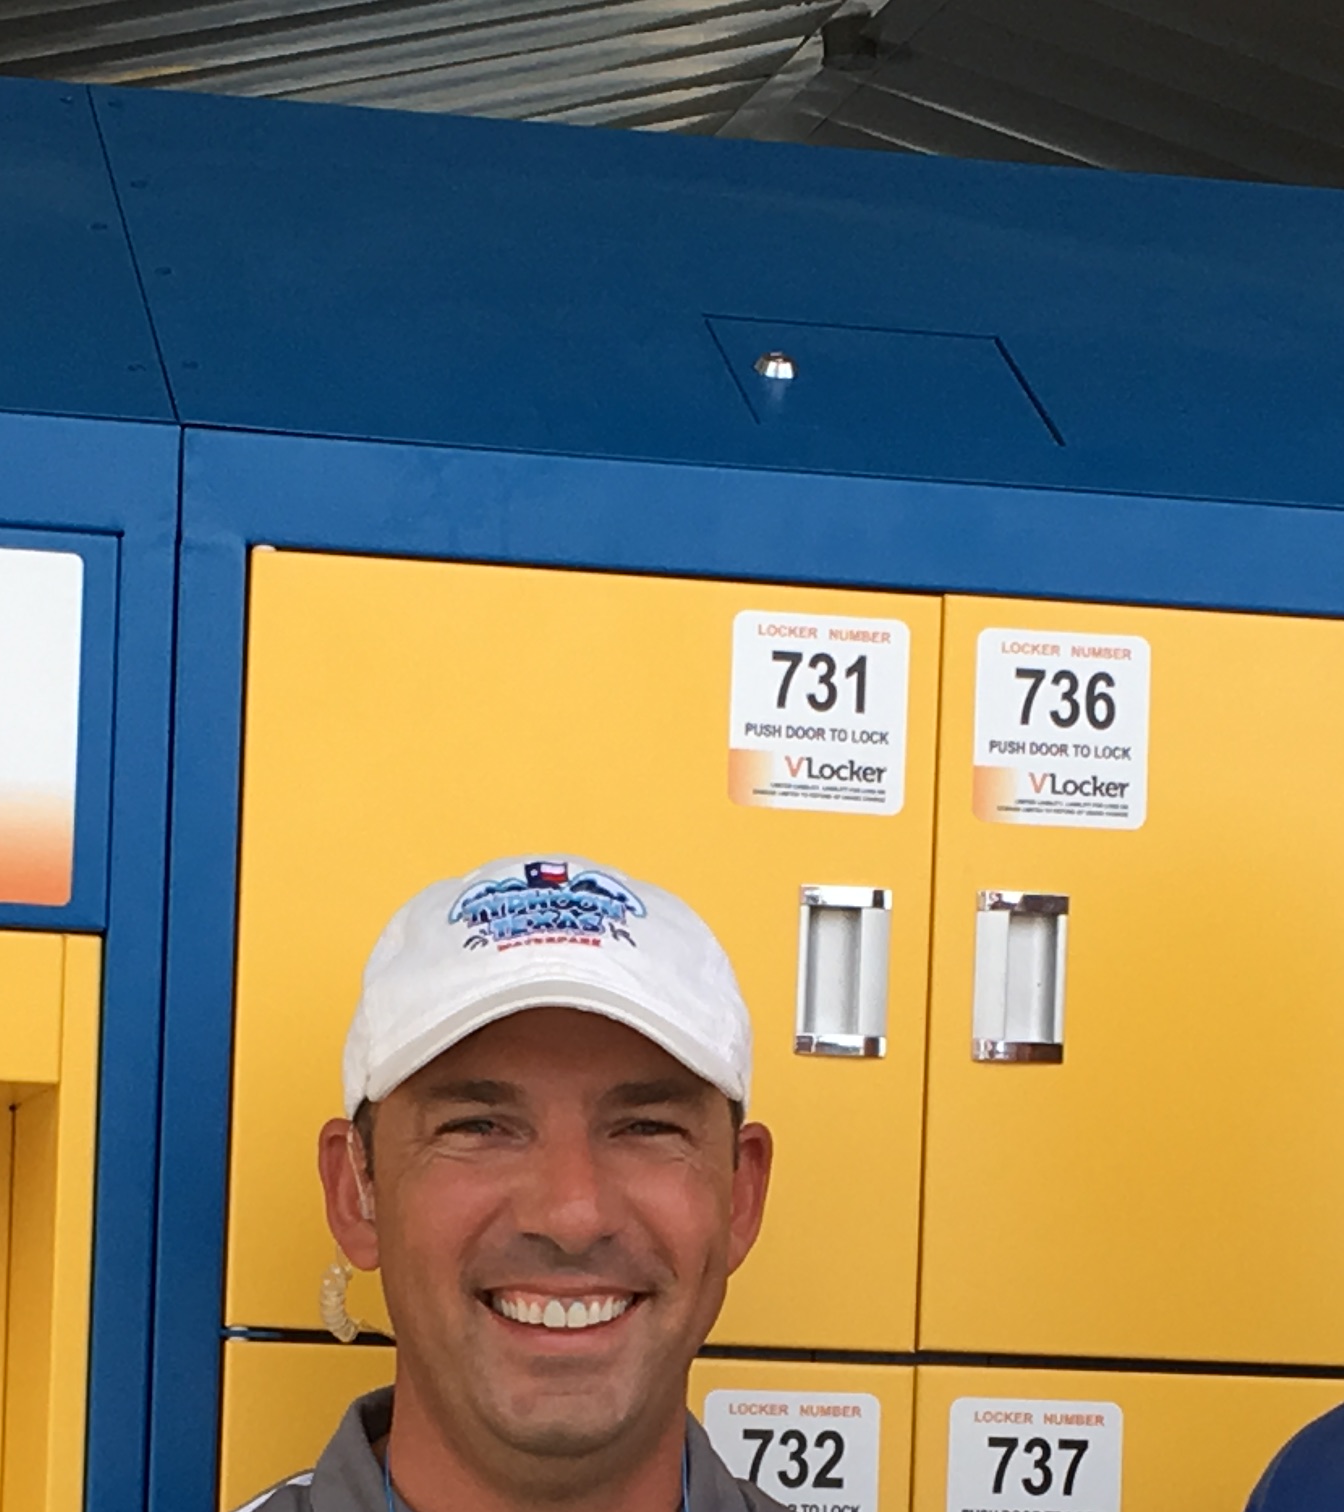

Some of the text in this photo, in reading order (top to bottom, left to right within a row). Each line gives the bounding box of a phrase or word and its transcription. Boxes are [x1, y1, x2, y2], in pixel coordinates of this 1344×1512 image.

[758, 624, 891, 644] LOCKER NUMBER
[1002, 642, 1132, 661] LOCKER NUMBER
[772, 650, 867, 714] 731
[1015, 668, 1116, 730] 736
[745, 723, 889, 745] PUSH DOOR TO LOCK
[989, 741, 1131, 761] PUSH DOOR TO LOCK
[785, 755, 887, 783] VLocker
[1028, 773, 1130, 798] VLocker
[488, 910, 605, 940] TEXAS
[729, 1403, 861, 1418] LOCKER NUMBER
[974, 1410, 1105, 1427] LOCKER NUMBER
[742, 1429, 844, 1489] 732
[987, 1437, 1088, 1496] 737
